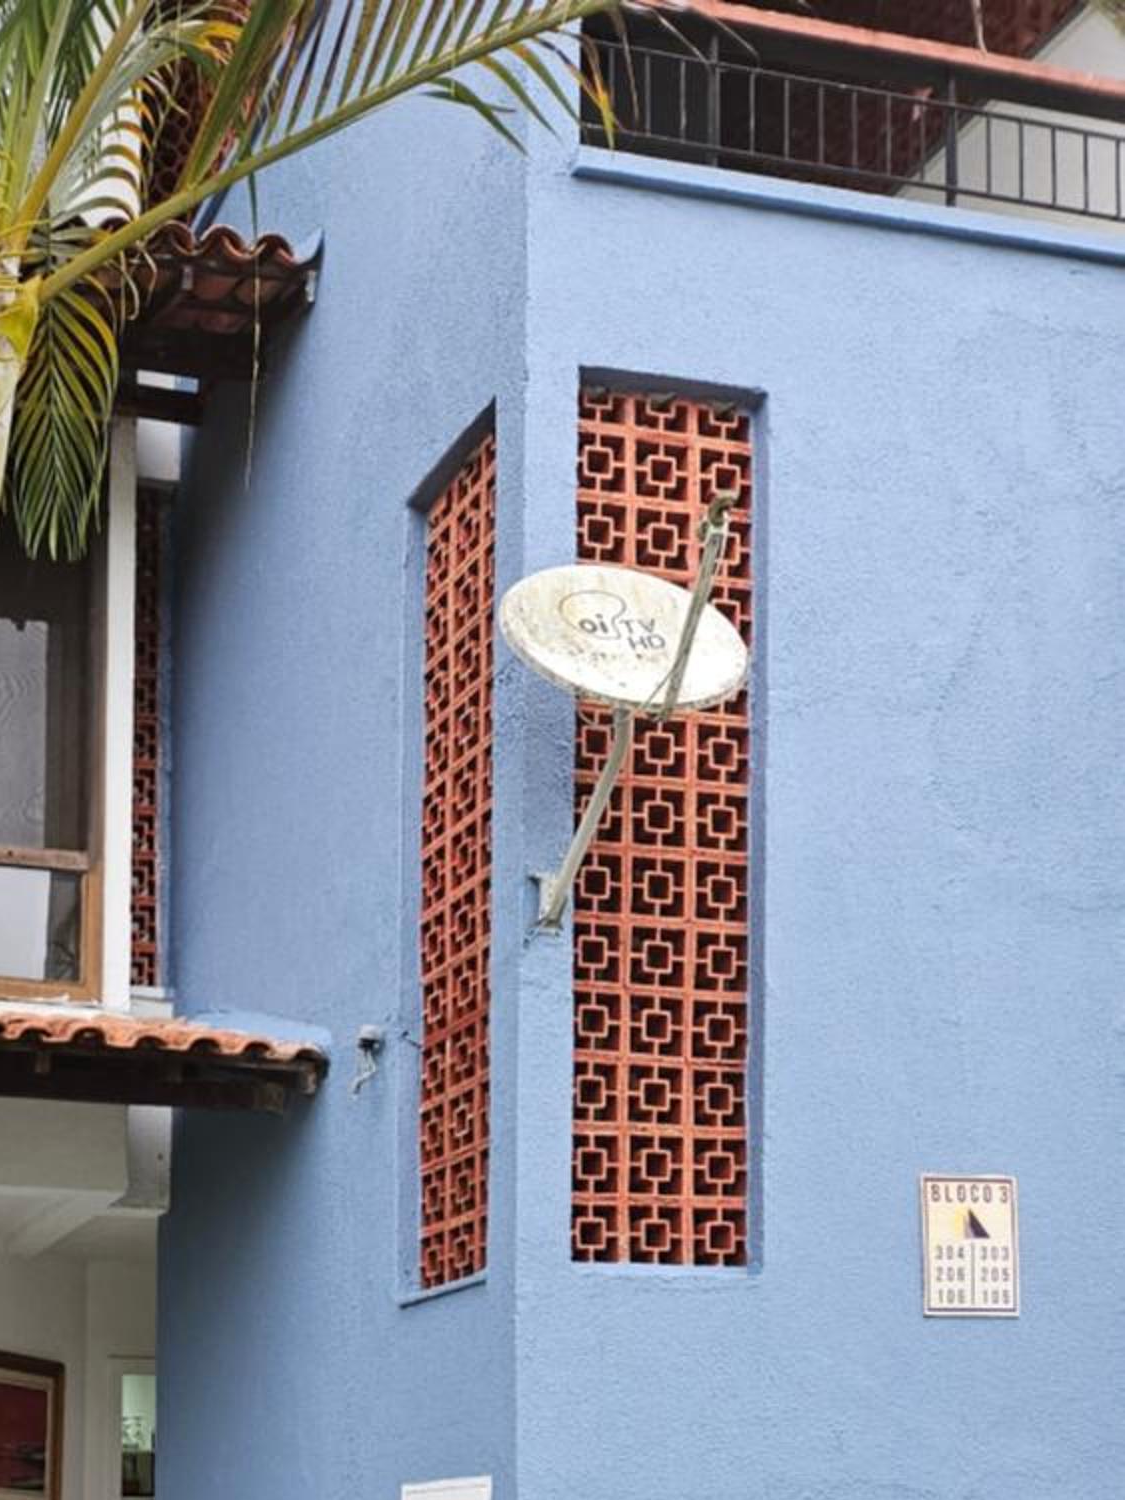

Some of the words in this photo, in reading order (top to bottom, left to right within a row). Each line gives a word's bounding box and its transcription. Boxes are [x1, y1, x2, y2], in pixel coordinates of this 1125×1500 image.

[578, 613, 610, 635] oi
[620, 618, 656, 634] TV
[627, 633, 666, 651] HD
[930, 1184, 993, 1203] BLOCO
[999, 1185, 1008, 1203] 3
[935, 1245, 965, 1260] 304
[980, 1267, 1010, 1282] 205
